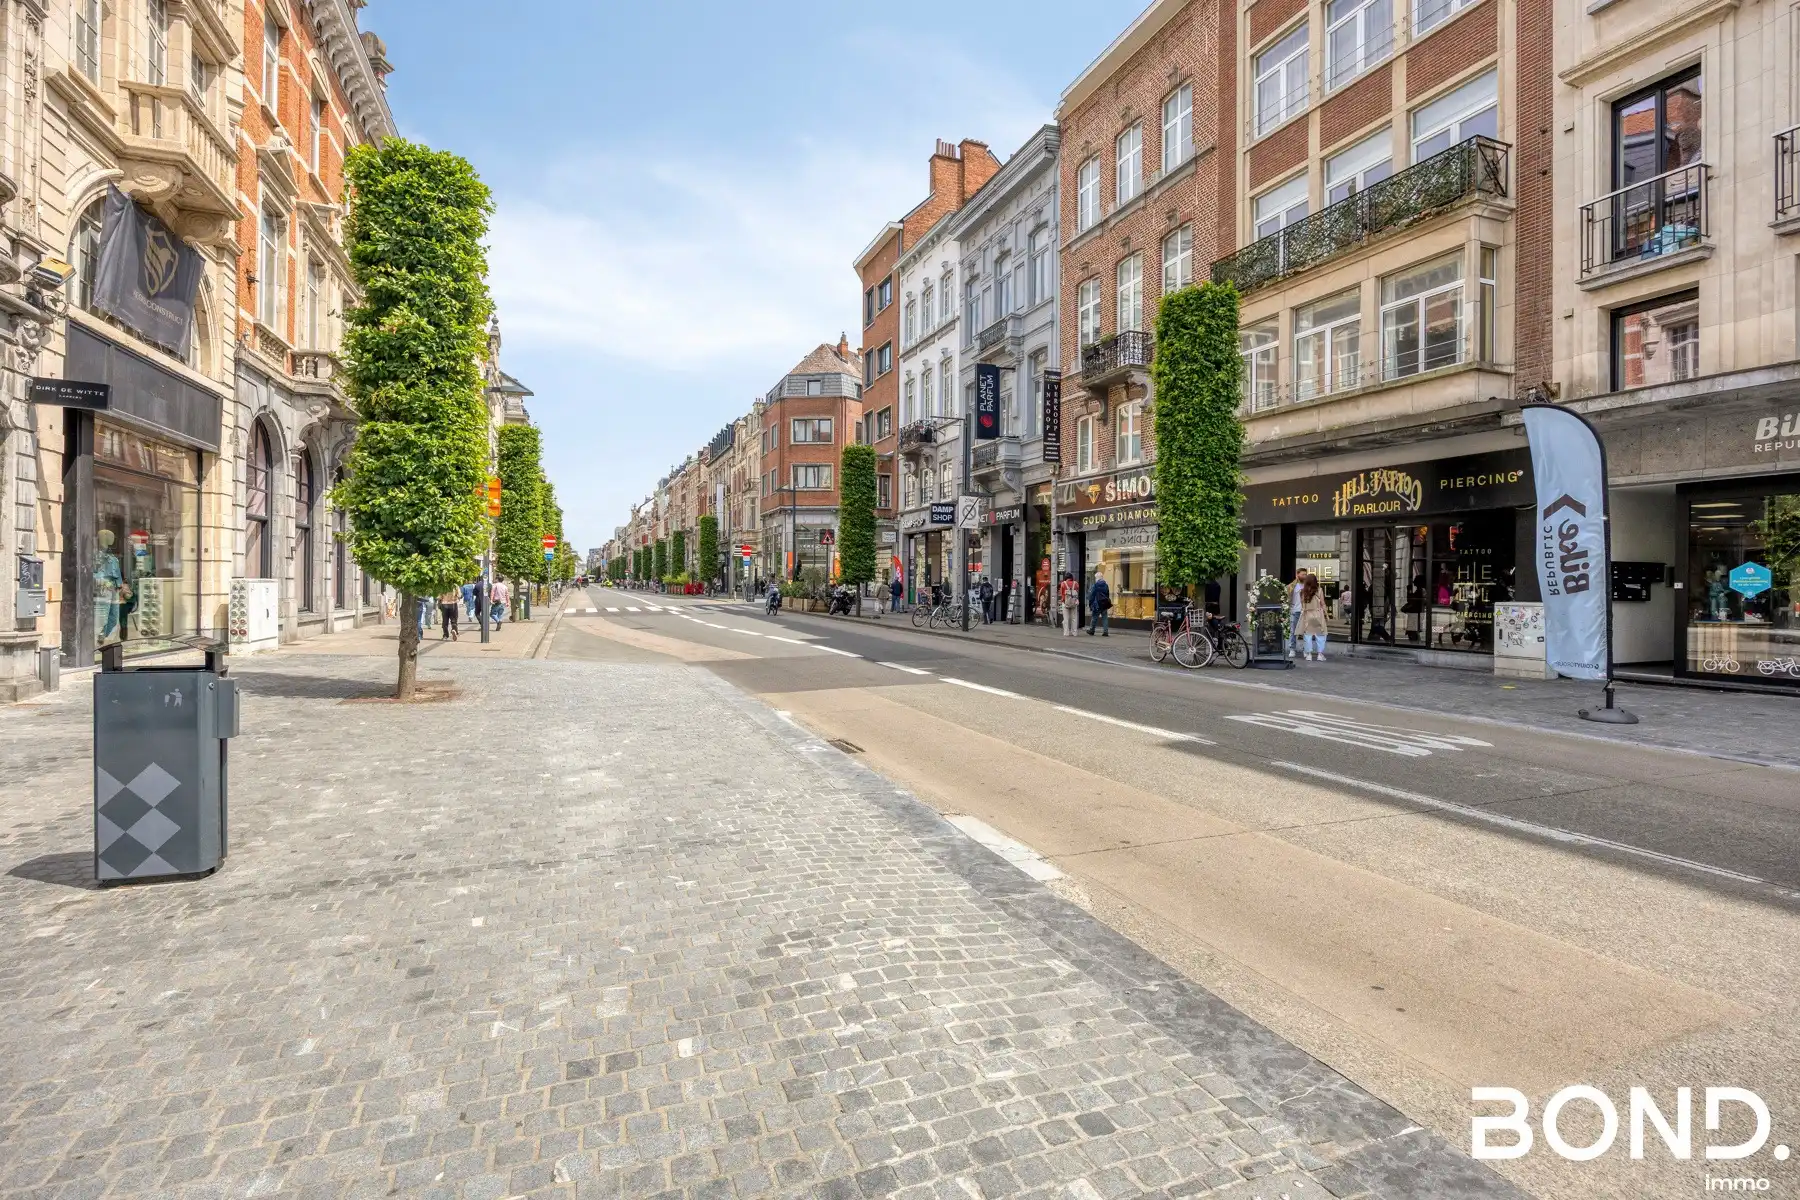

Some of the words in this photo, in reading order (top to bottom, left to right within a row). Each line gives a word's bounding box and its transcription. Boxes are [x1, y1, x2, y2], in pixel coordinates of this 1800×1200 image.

[76, 389, 105, 397] WITTE
[1754, 440, 1800, 453] REPU
[1440, 471, 1518, 490] PIERCING
[1333, 472, 1369, 517] HELL
[1370, 468, 1423, 511] TATTOO
[1272, 493, 1319, 507] TATTOO
[932, 505, 954, 513] DAMP
[1353, 500, 1401, 515] PARLOUR
[932, 513, 953, 521] SHOP
[996, 508, 1020, 520] PARFUM
[1082, 514, 1106, 525] GOLD
[1108, 513, 1115, 522] &
